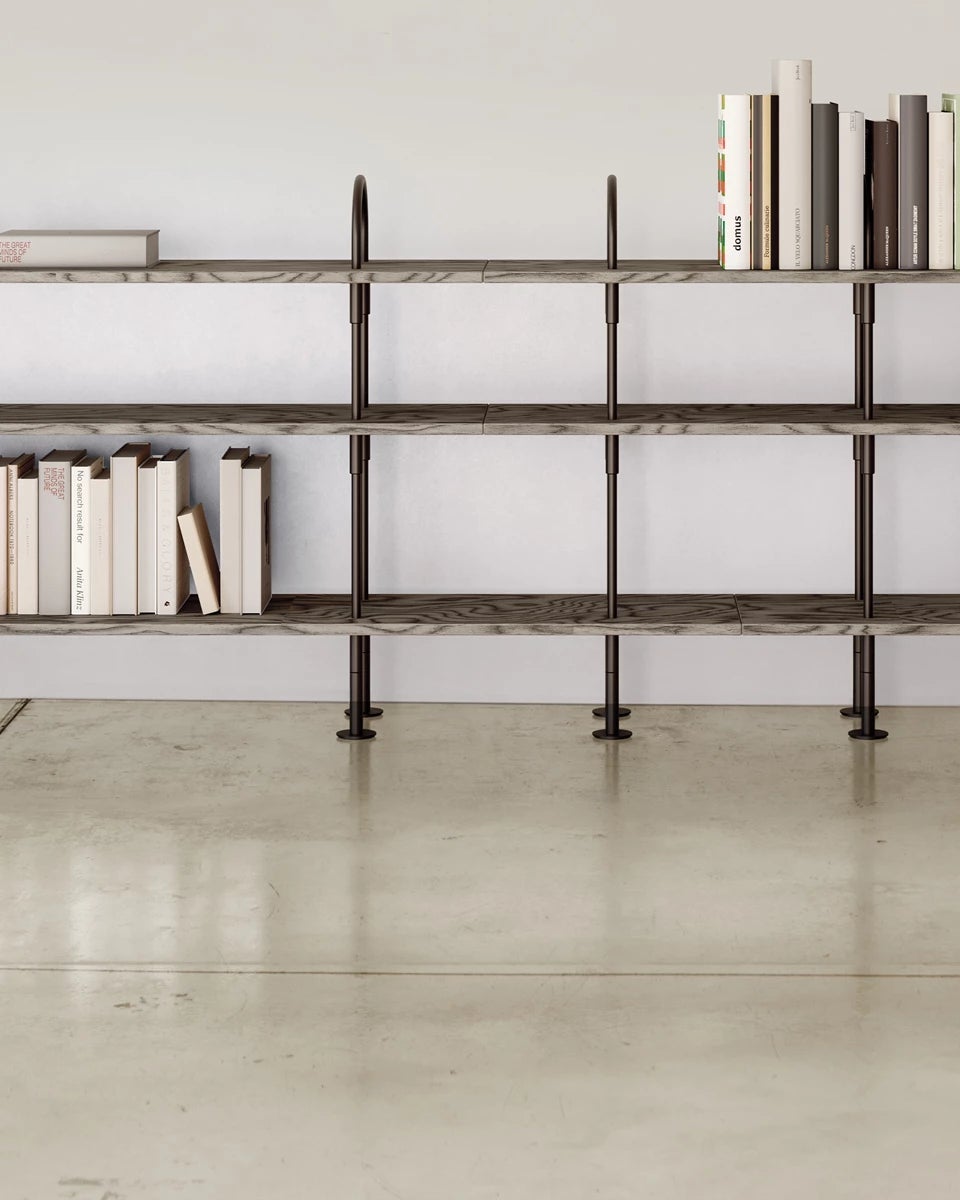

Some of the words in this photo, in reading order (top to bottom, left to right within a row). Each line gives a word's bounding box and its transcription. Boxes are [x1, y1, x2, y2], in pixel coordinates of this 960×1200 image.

[732, 215, 741, 251] domus
[77, 470, 84, 481] No
[51, 487, 57, 496] OF
[76, 567, 84, 588] Anita
[76, 590, 84, 611] Klinz
